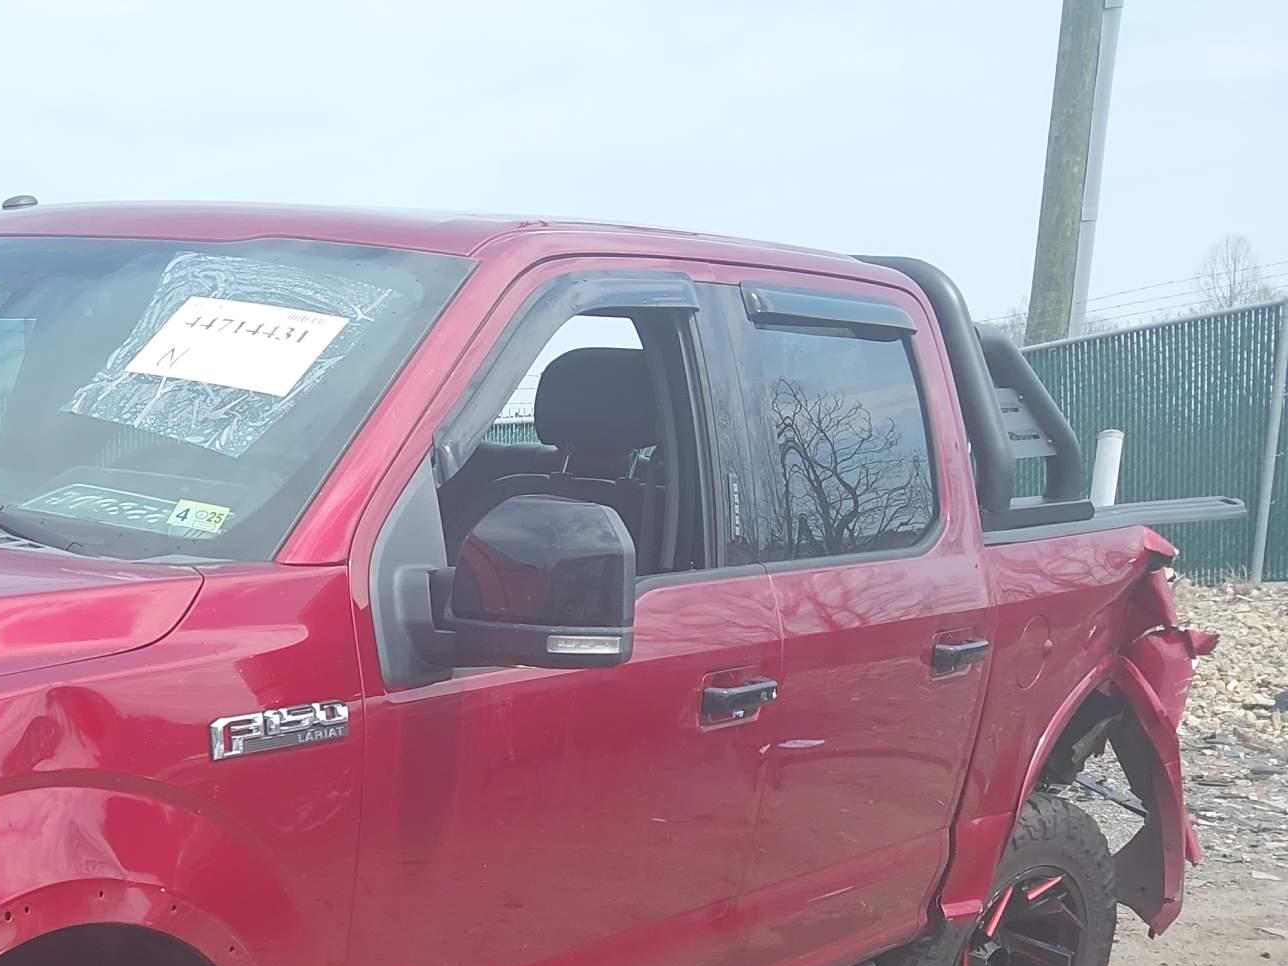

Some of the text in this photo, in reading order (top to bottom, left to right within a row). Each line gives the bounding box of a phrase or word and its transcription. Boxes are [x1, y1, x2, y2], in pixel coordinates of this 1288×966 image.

[185, 315, 309, 343] 44714431
[176, 508, 224, 523] 4 25
[297, 726, 344, 743] LARIAT
